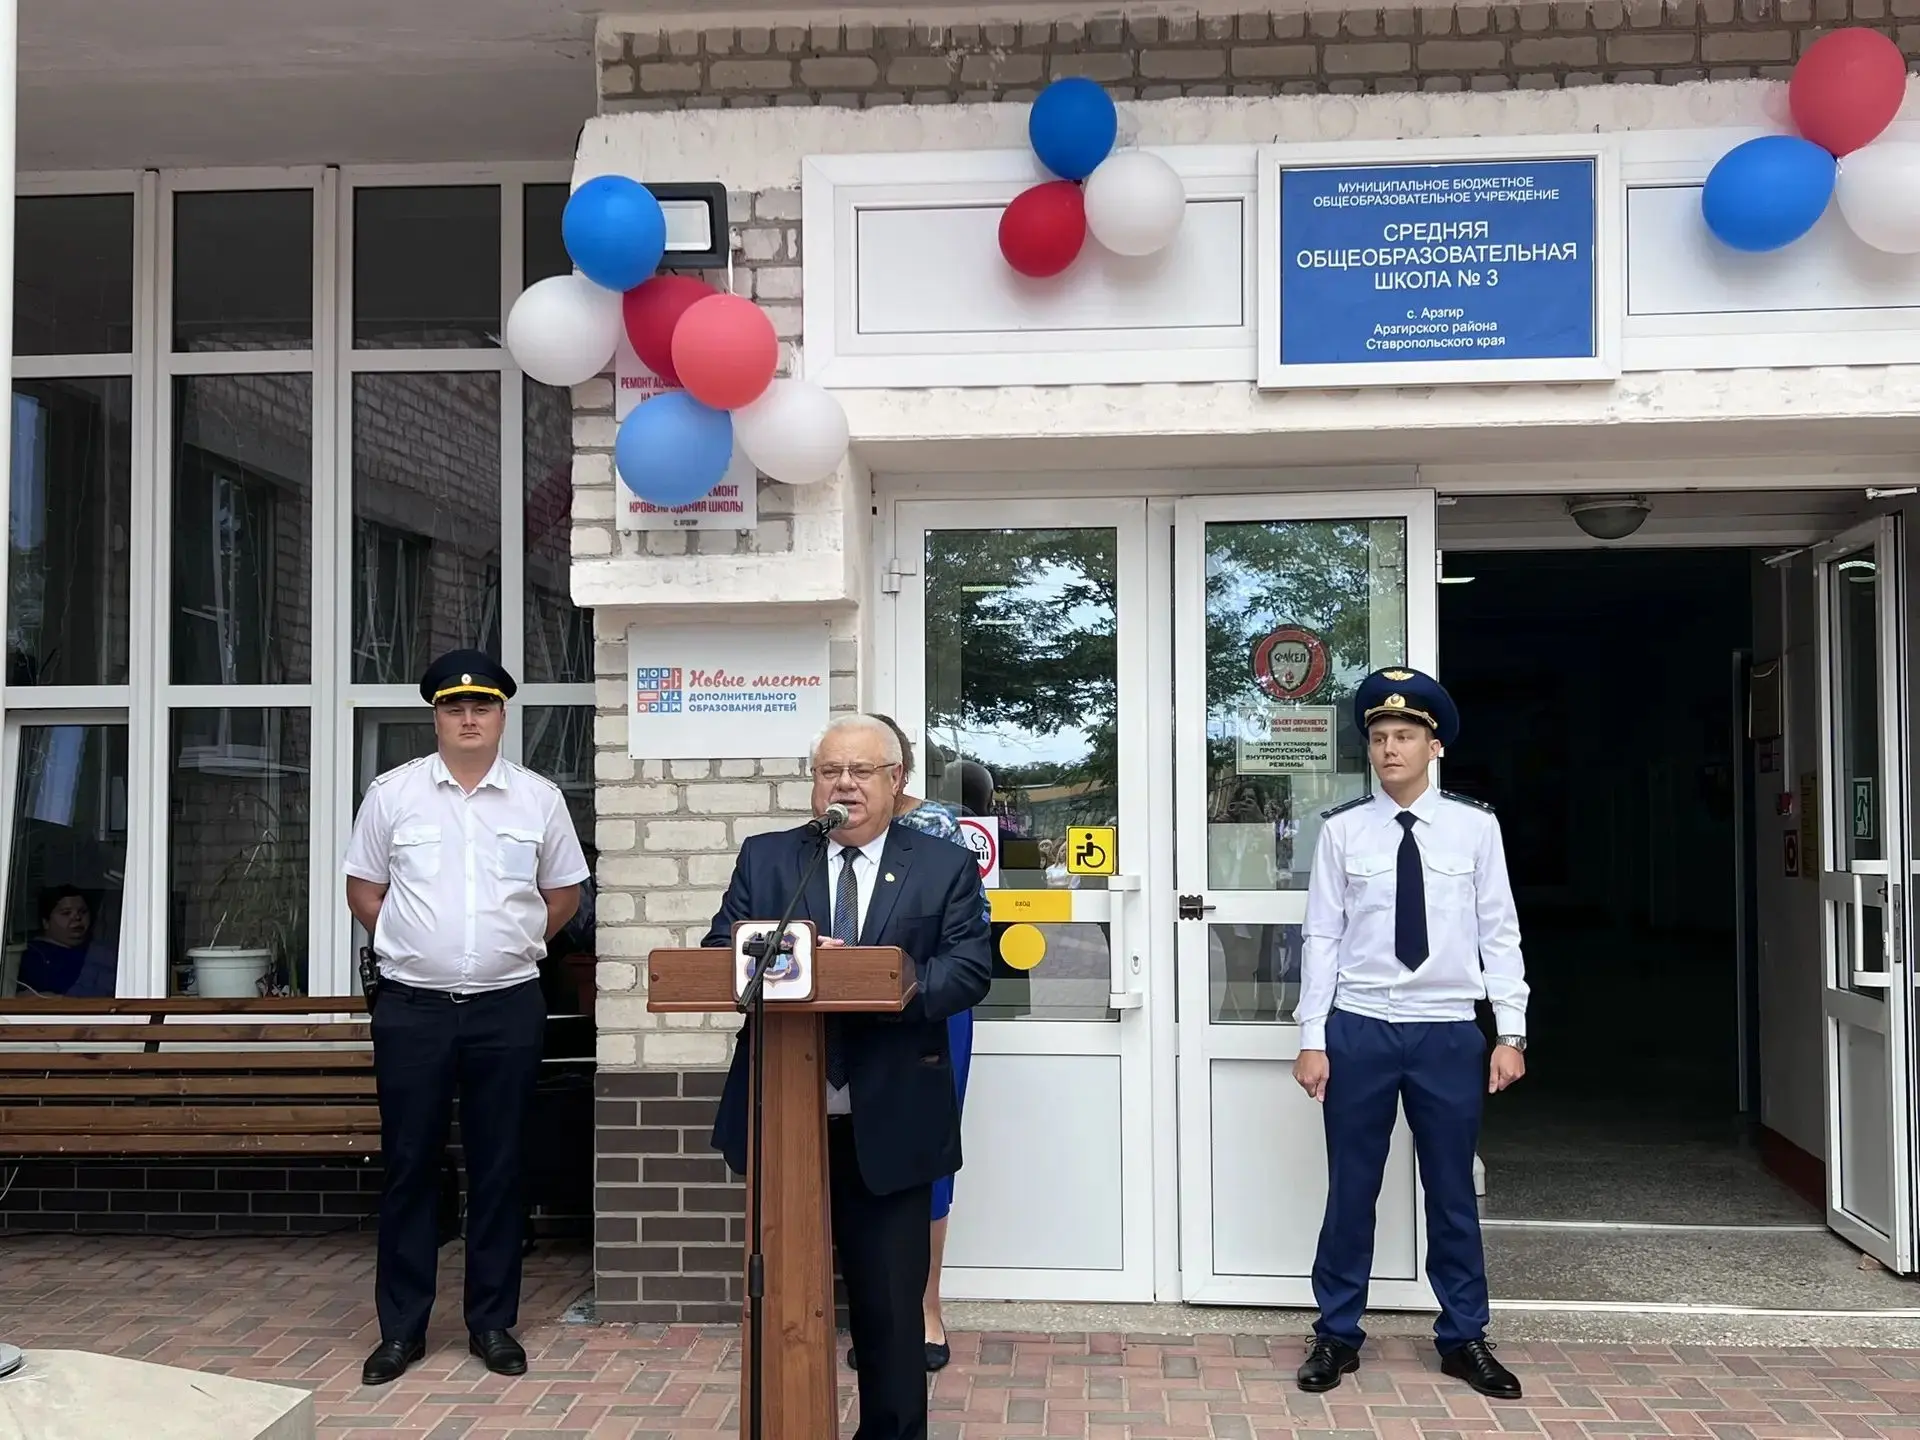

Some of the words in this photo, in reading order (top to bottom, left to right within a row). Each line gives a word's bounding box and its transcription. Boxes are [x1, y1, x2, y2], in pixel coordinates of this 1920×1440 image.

[1338, 178, 1449, 193] МУНИЦИПАЛЬНОЕ
[1453, 176, 1534, 190] БЮДЖЕТНОЕ
[1313, 191, 1470, 208] ОБЩЕОБРАЗОВАТЕЛЬНОЕ
[1474, 189, 1559, 203] УЧРЕЖДЕНИЕ
[1383, 221, 1489, 244] СРЕДНЯЯ
[1296, 242, 1577, 271] ОБЩЕОБРАЗОВАТЕЛЬНАЯ
[1374, 270, 1451, 290] ШКОЛА
[1458, 270, 1480, 287] №
[1486, 269, 1499, 286] 3
[1406, 308, 1417, 319] с.
[1421, 306, 1464, 322] Арзгир
[1374, 321, 1449, 336] Арзгирского
[1453, 320, 1497, 334] района
[1366, 336, 1473, 351] Ставропольского
[1477, 336, 1506, 349] края
[621, 377, 652, 389] РЕМОНТ
[708, 501, 743, 513] ШКОЛЫ
[1275, 649, 1306, 664] ФАКЕЛ
[689, 669, 747, 687] Новые
[752, 674, 821, 687] места
[689, 692, 797, 702] ДОПОЛНИТЕЛЬНОГО
[689, 704, 762, 712] ОБРАЗОВАНИЯ
[764, 702, 797, 713] ДЕТЕЙ
[1245, 753, 1328, 761] ВНУТРИОБЪЕКТОВЫЙ
[1259, 746, 1314, 754] ПРОПУСКНОЙ,
